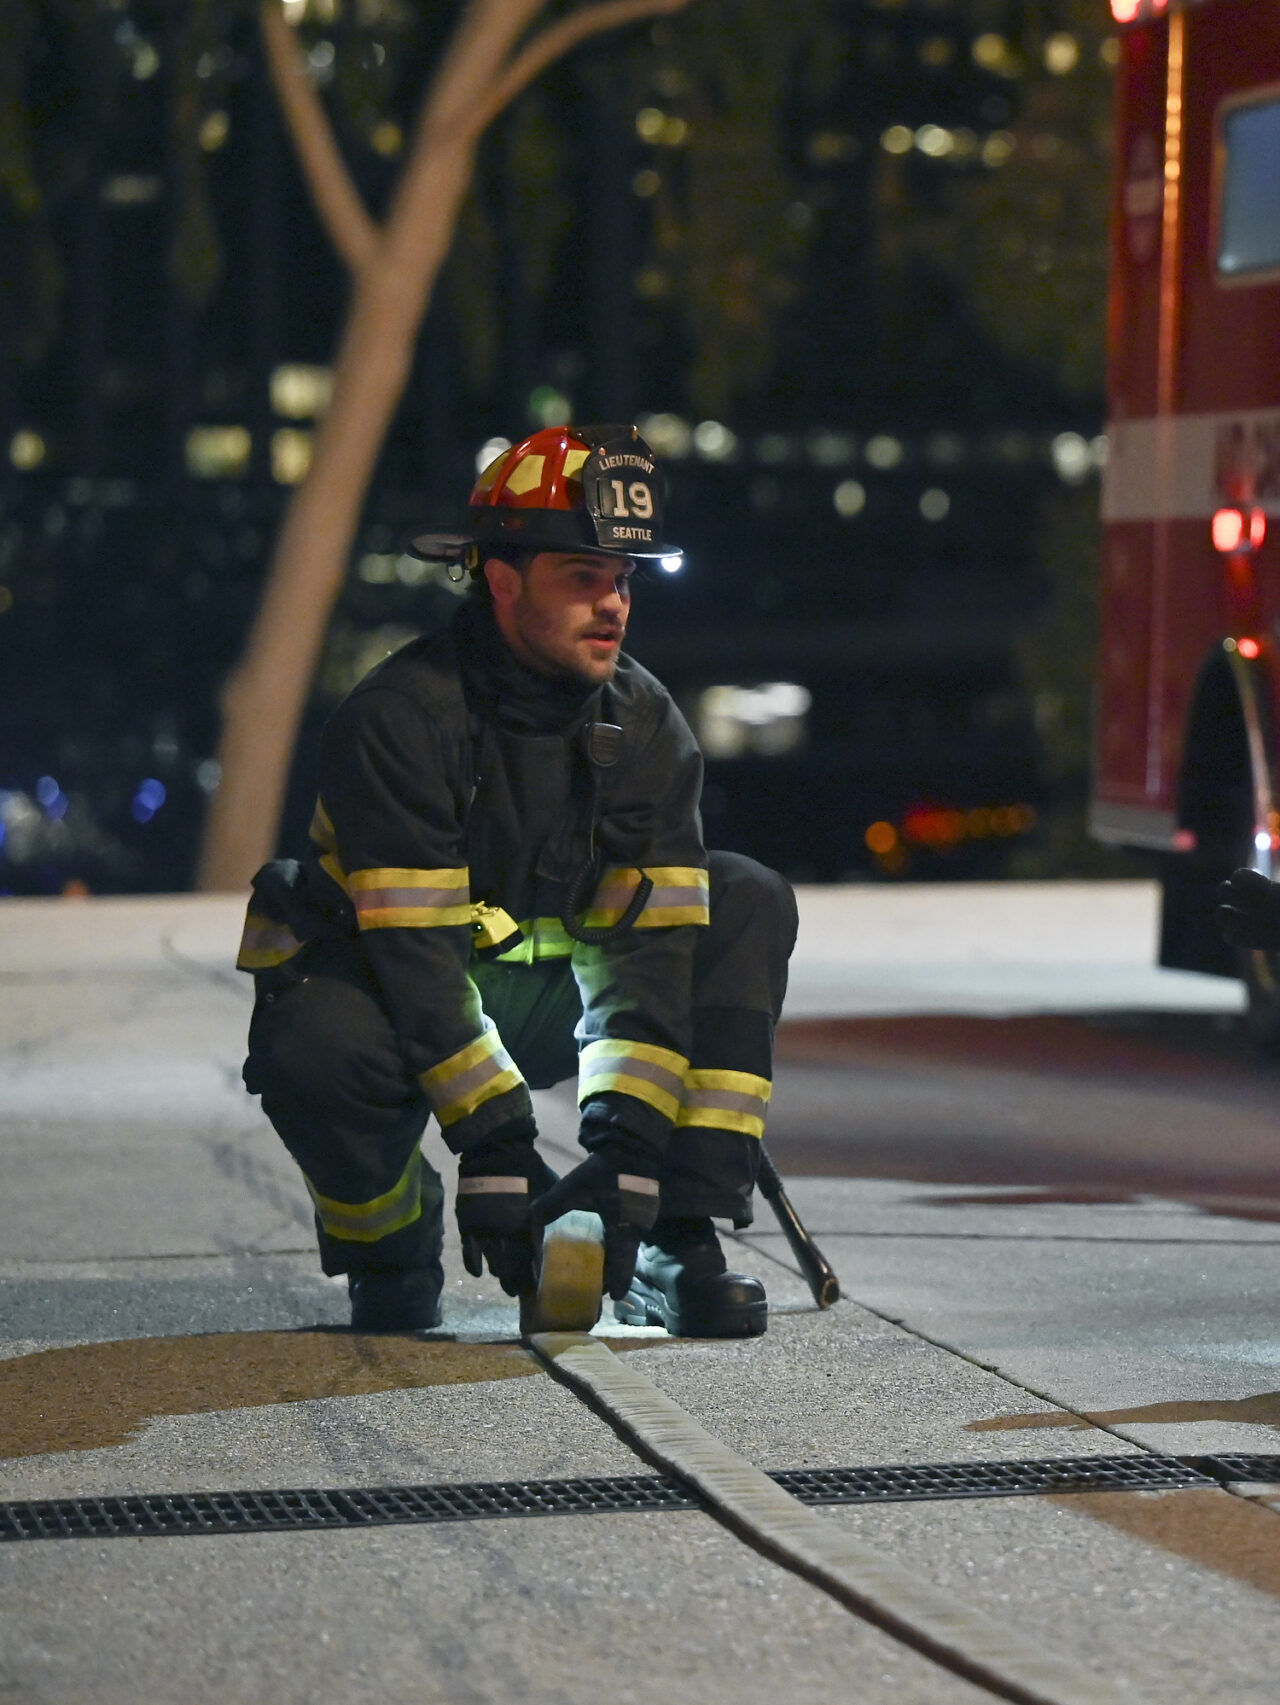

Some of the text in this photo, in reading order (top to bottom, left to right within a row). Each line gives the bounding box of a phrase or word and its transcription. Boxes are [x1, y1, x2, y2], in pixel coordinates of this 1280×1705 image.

[599, 454, 655, 475] LIEUTENANT
[611, 480, 654, 519] 19
[612, 526, 653, 541] SEATTLE
